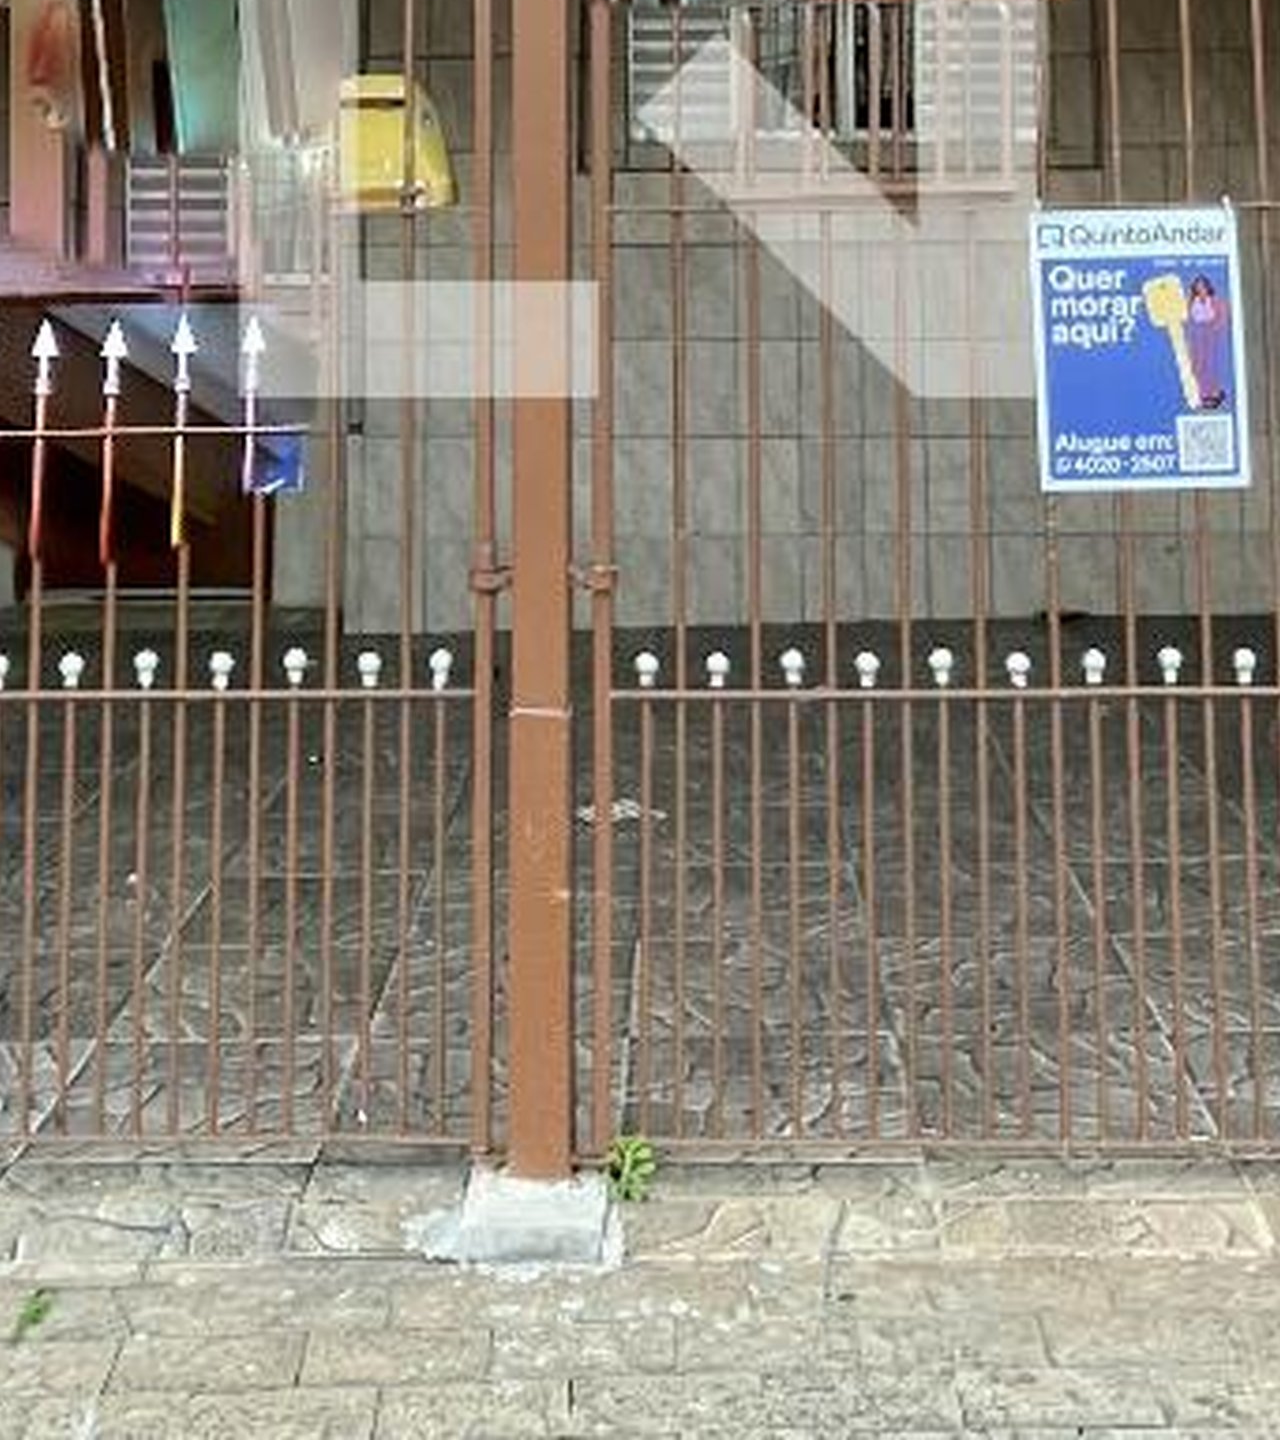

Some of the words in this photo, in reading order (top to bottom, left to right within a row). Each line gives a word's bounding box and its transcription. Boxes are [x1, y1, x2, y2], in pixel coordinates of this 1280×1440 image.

[1069, 221, 1226, 248] QuintoAndar
[1049, 265, 1126, 291] Quer
[1051, 295, 1144, 319] morar
[1052, 317, 1137, 349] aqui?
[1055, 433, 1131, 455] Alugue
